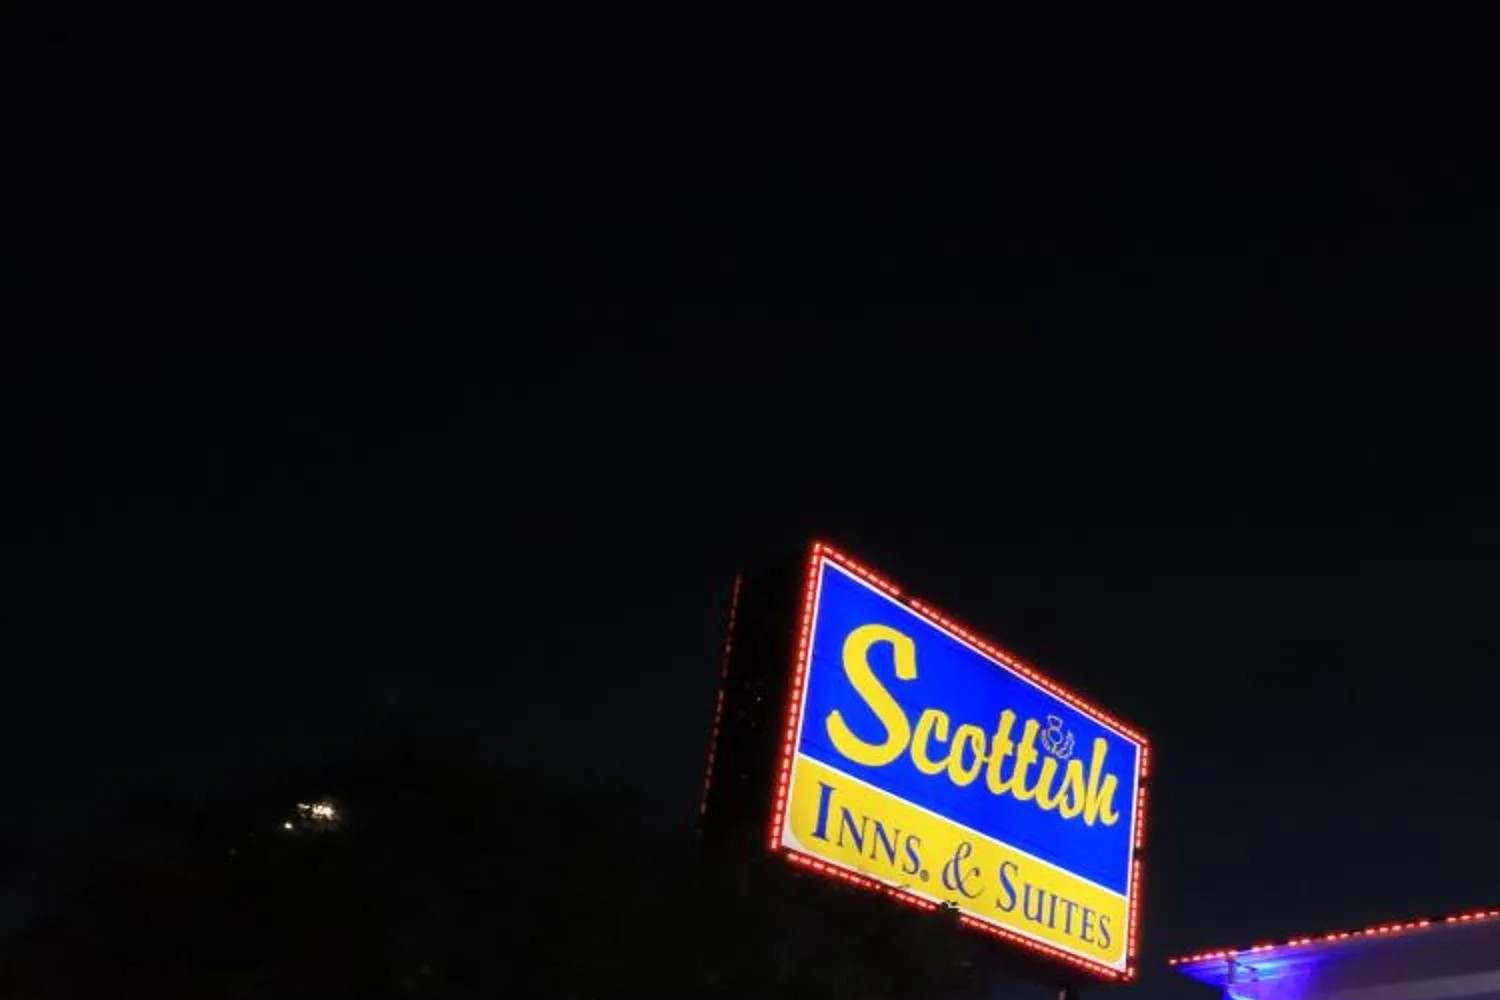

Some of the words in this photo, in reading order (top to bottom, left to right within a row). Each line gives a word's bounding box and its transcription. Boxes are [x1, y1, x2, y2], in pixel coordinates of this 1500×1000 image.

[825, 624, 1120, 827] Scottish
[942, 841, 985, 899] &
[996, 861, 1112, 951] SUITES
